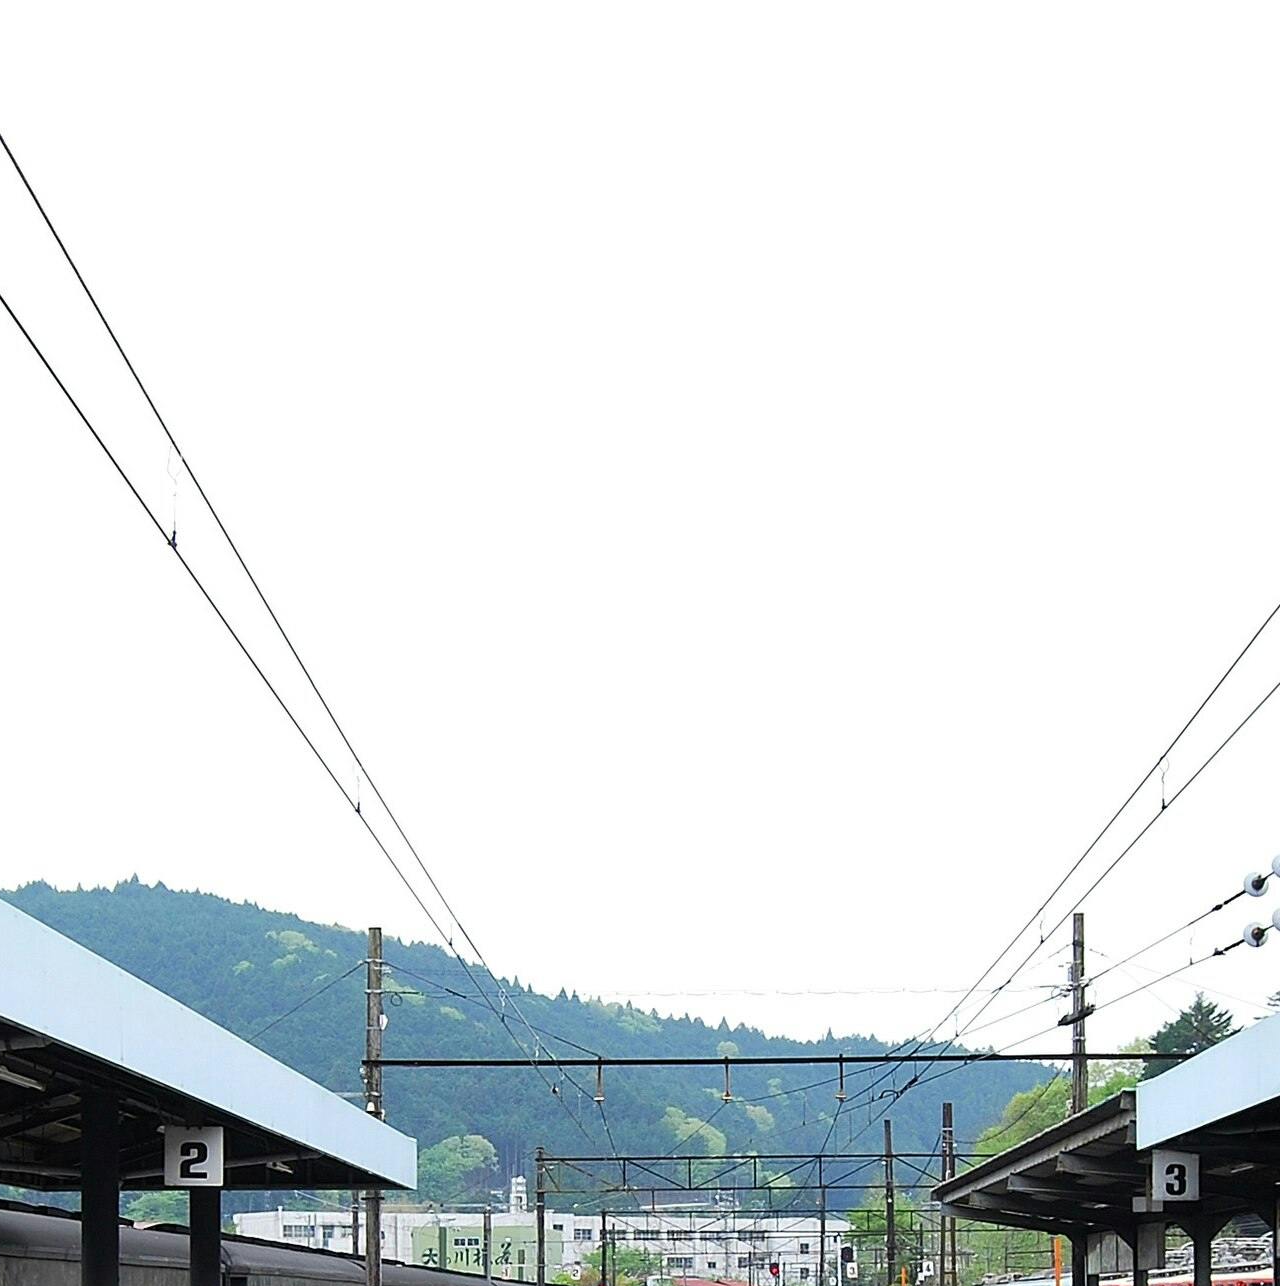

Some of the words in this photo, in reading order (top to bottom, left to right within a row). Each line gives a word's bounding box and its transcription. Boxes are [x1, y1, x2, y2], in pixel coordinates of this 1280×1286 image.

[180, 1142, 208, 1179] 2
[1165, 1163, 1187, 1196] 3
[572, 1268, 580, 1278] 2
[848, 1266, 856, 1276] 3
